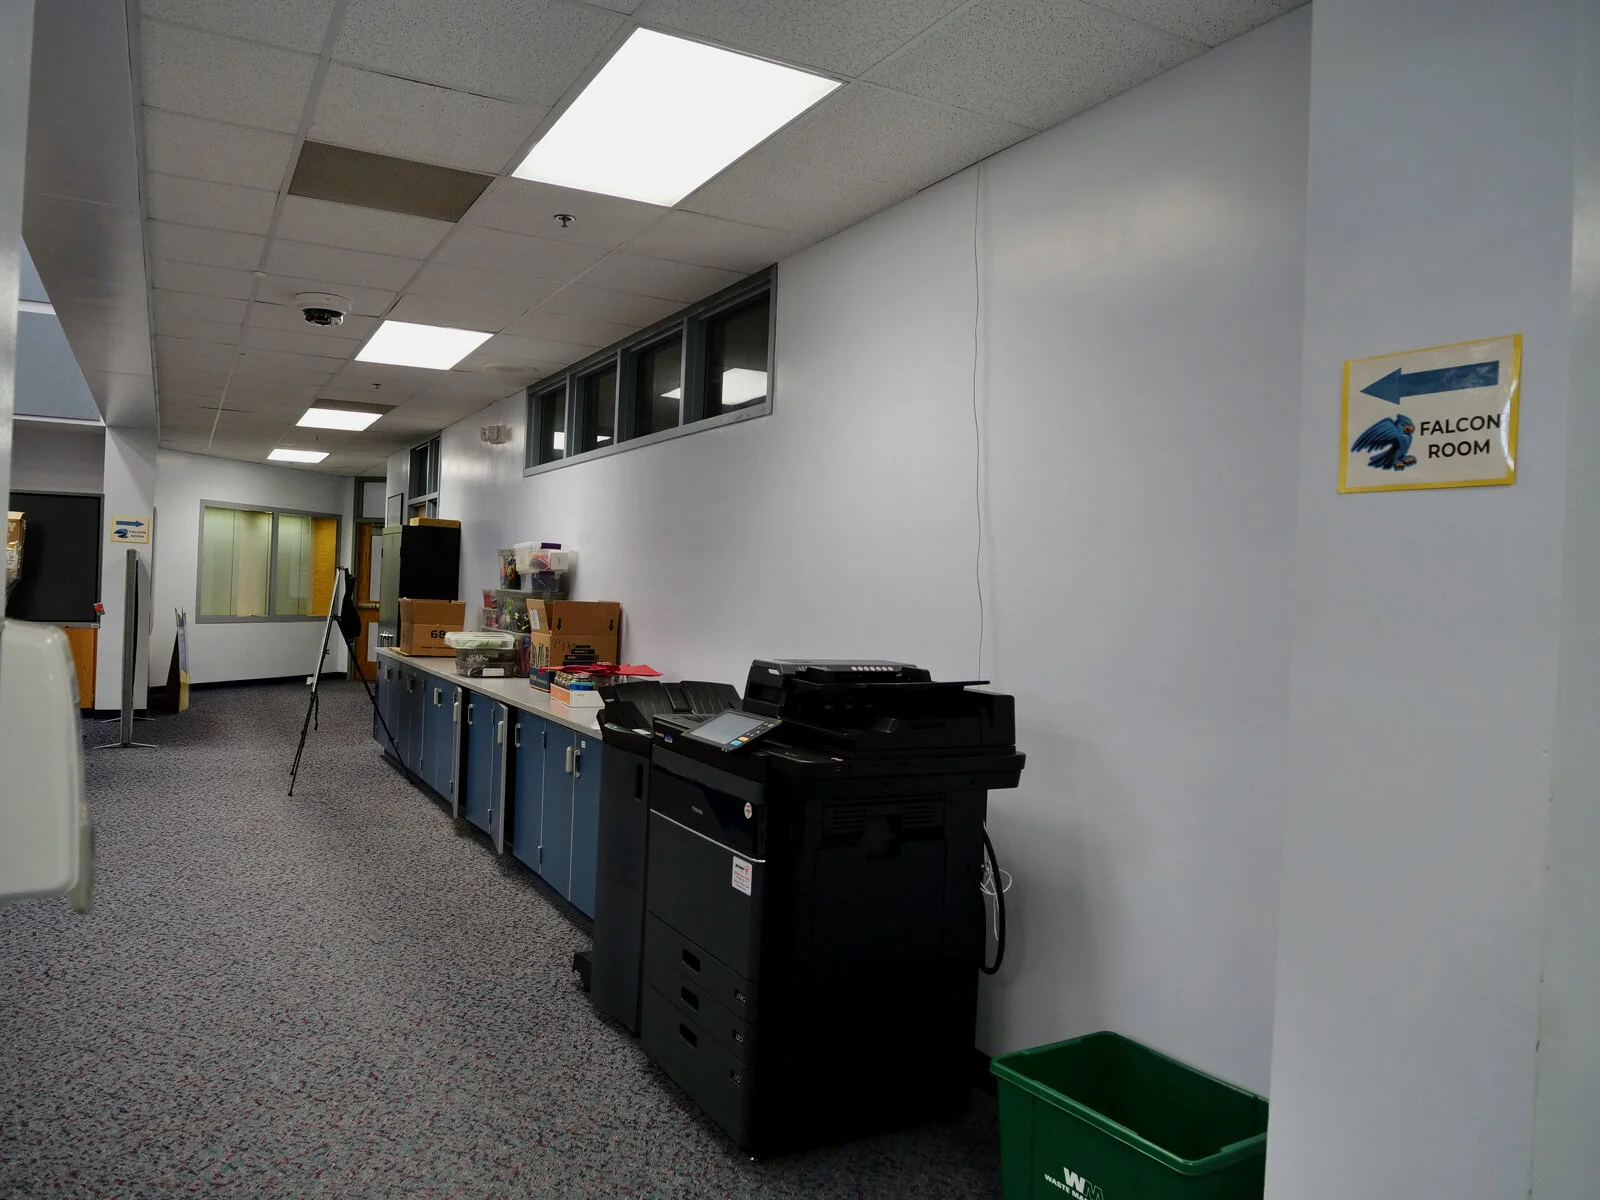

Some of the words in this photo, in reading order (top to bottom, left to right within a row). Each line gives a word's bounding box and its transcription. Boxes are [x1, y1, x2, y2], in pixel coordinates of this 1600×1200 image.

[1420, 413, 1500, 436] FALCON
[1428, 439, 1491, 459] ROOM
[430, 630, 446, 639] 68
[1044, 1173, 1071, 1194] WASTE
